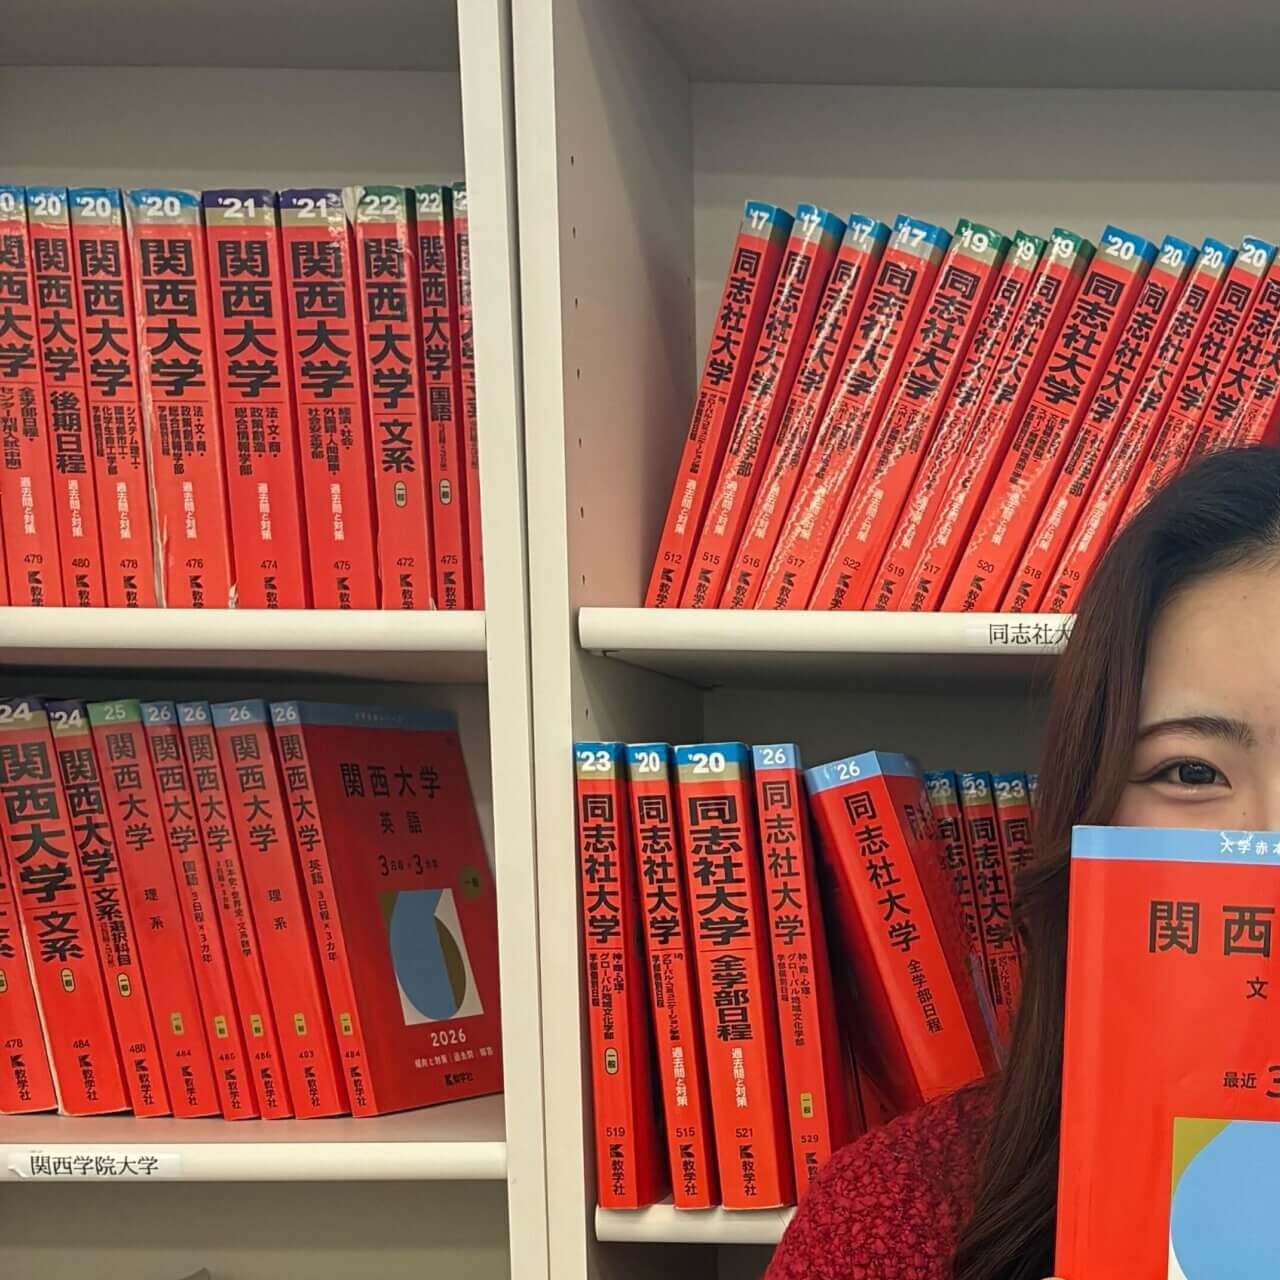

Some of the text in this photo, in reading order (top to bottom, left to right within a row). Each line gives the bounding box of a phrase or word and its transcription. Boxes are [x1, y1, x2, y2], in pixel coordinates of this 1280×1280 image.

[218, 197, 255, 218] '21
[292, 197, 328, 218] '21
[1106, 235, 1134, 260] '20
[34, 238, 80, 381] 関西大学
[79, 240, 132, 396] 関西大学
[140, 239, 205, 396] 関西大学
[218, 240, 280, 397] 関西大学
[291, 241, 353, 398] 関西大学
[363, 238, 414, 409] 関西大学
[420, 236, 450, 380] 関西大学
[706, 249, 759, 386] 同志社大学
[1040, 272, 1124, 405] 同志社大学
[50, 391, 87, 474] 後期日程
[380, 419, 415, 473] 文系
[24, 554, 43, 564] 479
[664, 554, 682, 564] 512
[703, 554, 720, 564] 515
[844, 557, 861, 570] 522
[977, 562, 994, 574] 520
[106, 733, 154, 851] 関西大学
[150, 734, 199, 853] 関西大学
[187, 734, 237, 853] 関西大学
[230, 734, 278, 852] 関西大学
[280, 734, 321, 852] 関西大学
[340, 763, 440, 798] 関西大学
[577, 752, 611, 772] '23
[635, 752, 660, 773] '20
[689, 753, 725, 773] '20
[59, 749, 117, 883] 関西大学
[582, 794, 621, 944] 同志社大学
[638, 795, 681, 946] 同志社大学
[688, 795, 750, 945] 同志社大学
[761, 781, 804, 944] 同志社大学
[844, 791, 920, 953] 同志社大学
[33, 909, 84, 962] 文系
[710, 955, 753, 1041] 全学部日程
[907, 959, 943, 1032] 全学部日程
[431, 1028, 466, 1047] 2026
[31, 1155, 159, 1176] 関西学院大学
[606, 1127, 625, 1137] 519
[736, 1128, 753, 1137] 521
[801, 1135, 819, 1143] 529
[611, 1160, 625, 1196] 教学社
[682, 1160, 697, 1196] 教学社
[741, 1160, 757, 1196] 教学社
